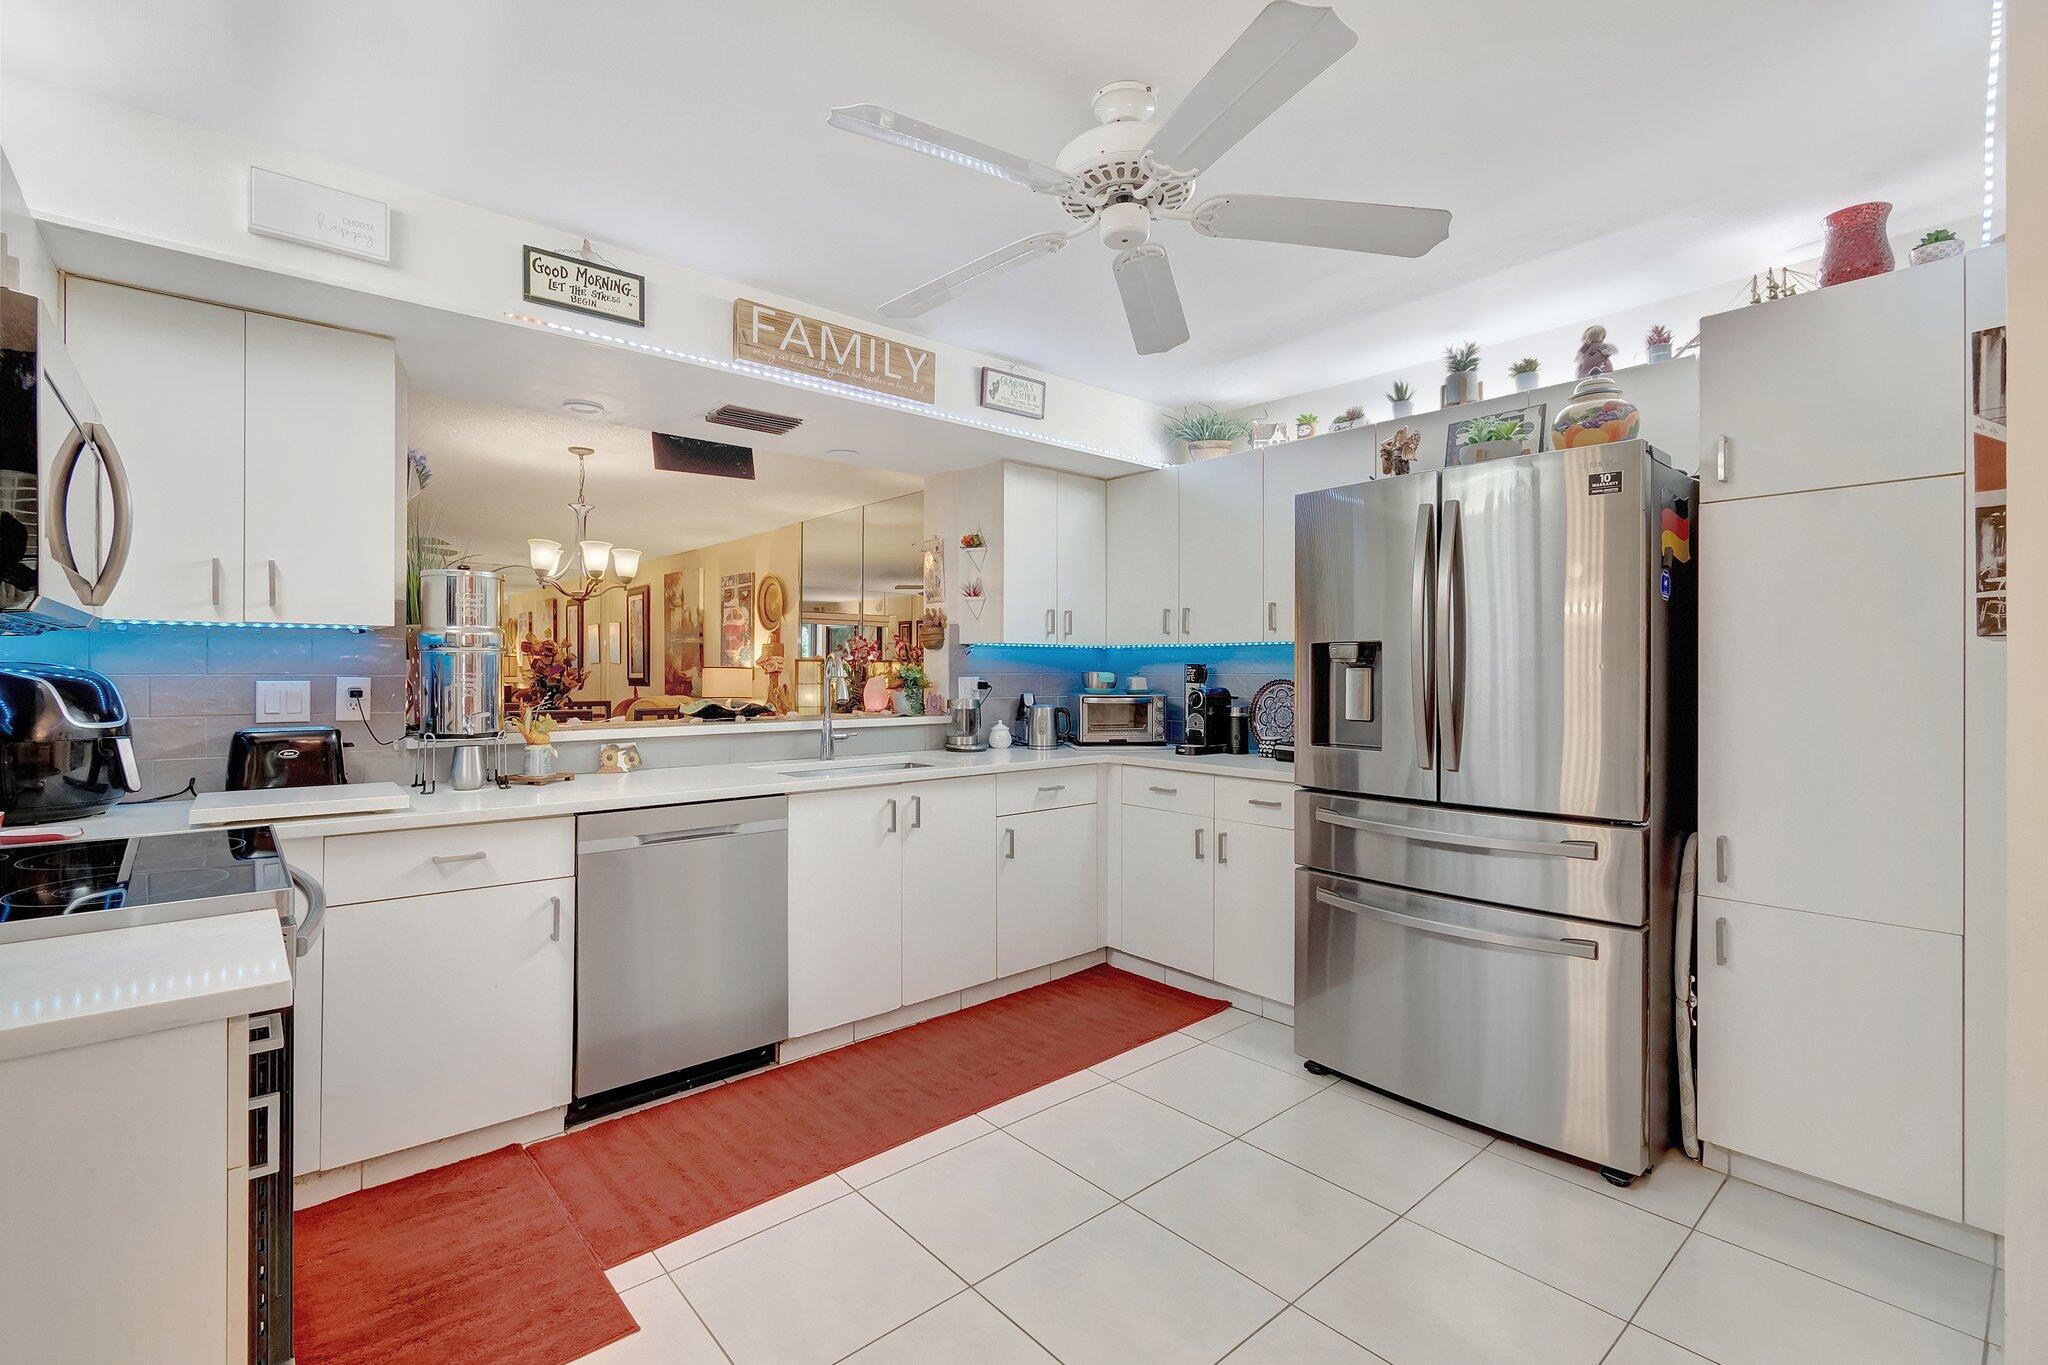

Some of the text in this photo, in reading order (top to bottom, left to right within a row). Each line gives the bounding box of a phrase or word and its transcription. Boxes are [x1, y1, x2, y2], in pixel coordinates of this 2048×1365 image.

[317, 213, 374, 249] happy
[342, 217, 376, 232] CHOOSE
[548, 278, 621, 304] LET THE STRESS
[752, 305, 928, 383] FAMILY
[1599, 473, 1611, 483] 10
